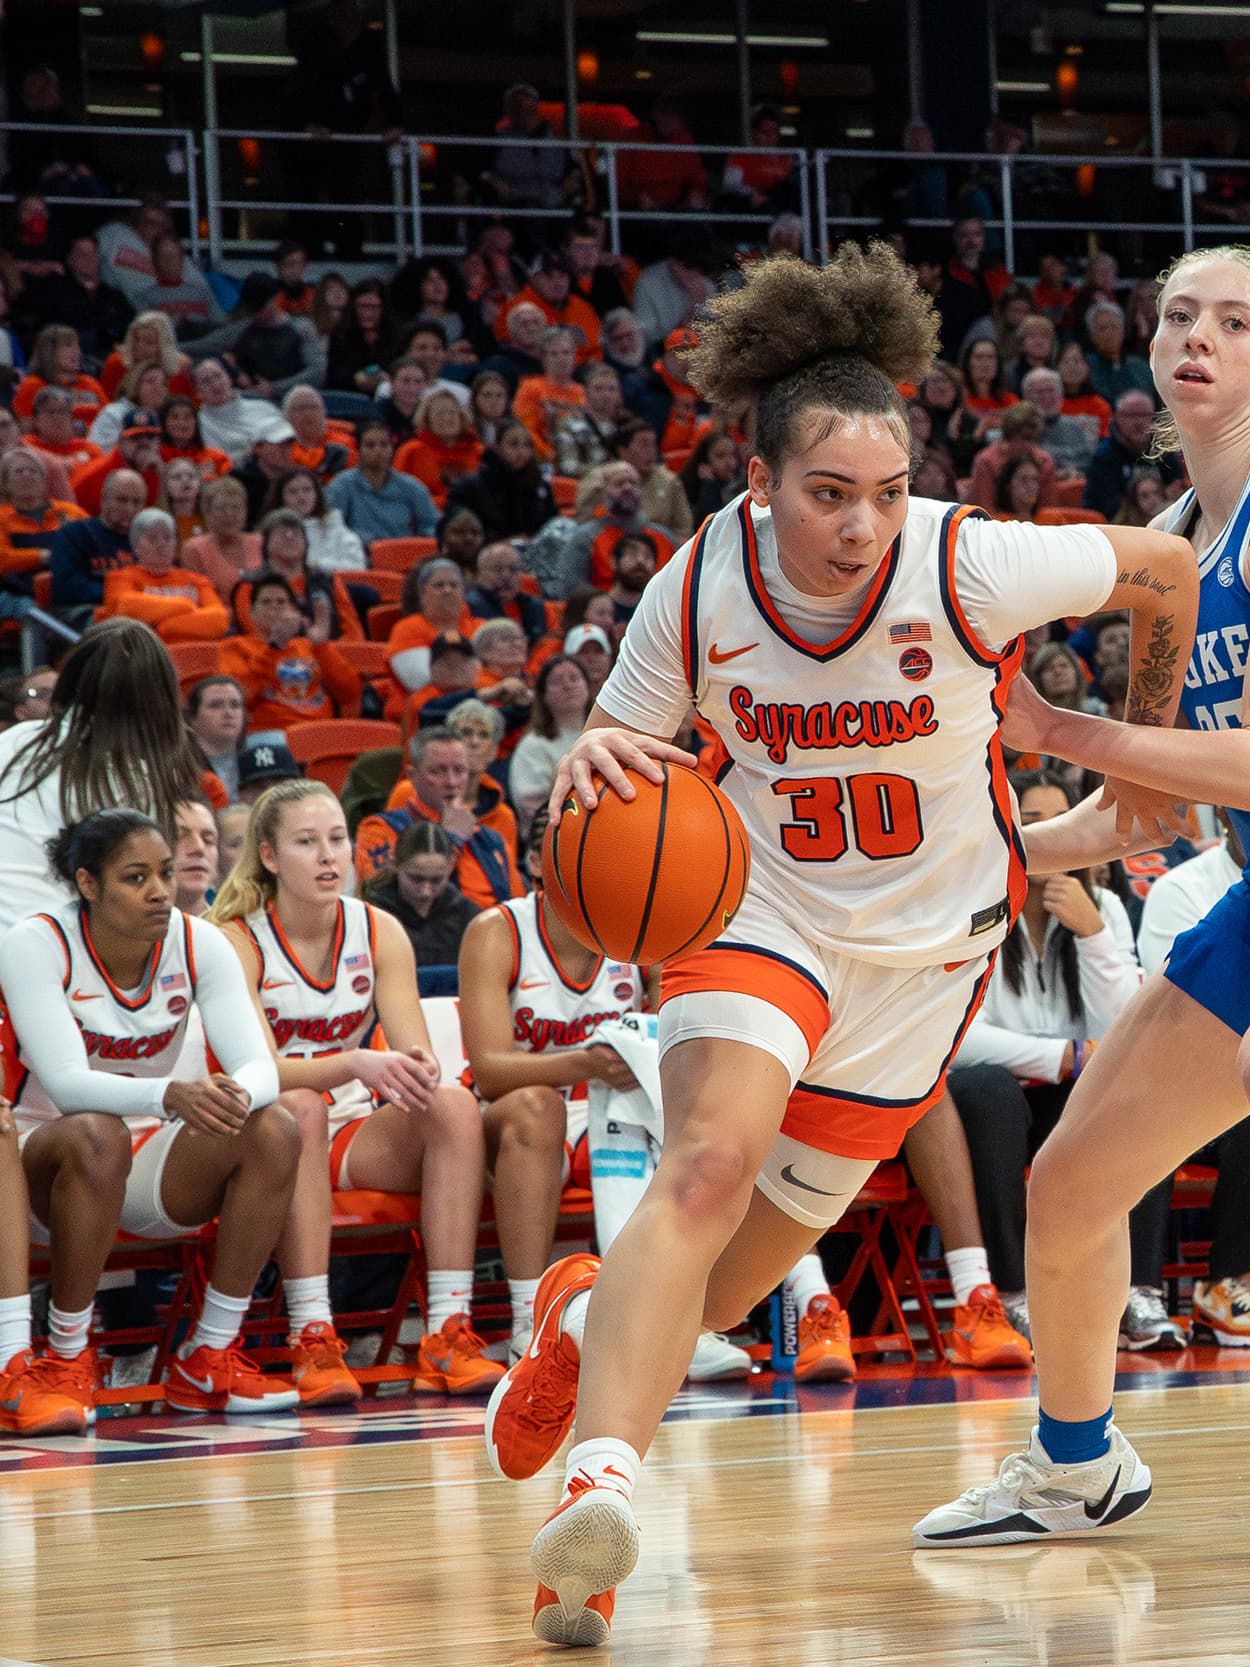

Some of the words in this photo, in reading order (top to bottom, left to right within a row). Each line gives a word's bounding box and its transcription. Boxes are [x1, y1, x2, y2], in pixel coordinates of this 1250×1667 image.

[1130, 567, 1151, 587] this
[729, 685, 939, 765] Syracuse
[770, 772, 925, 862] 30
